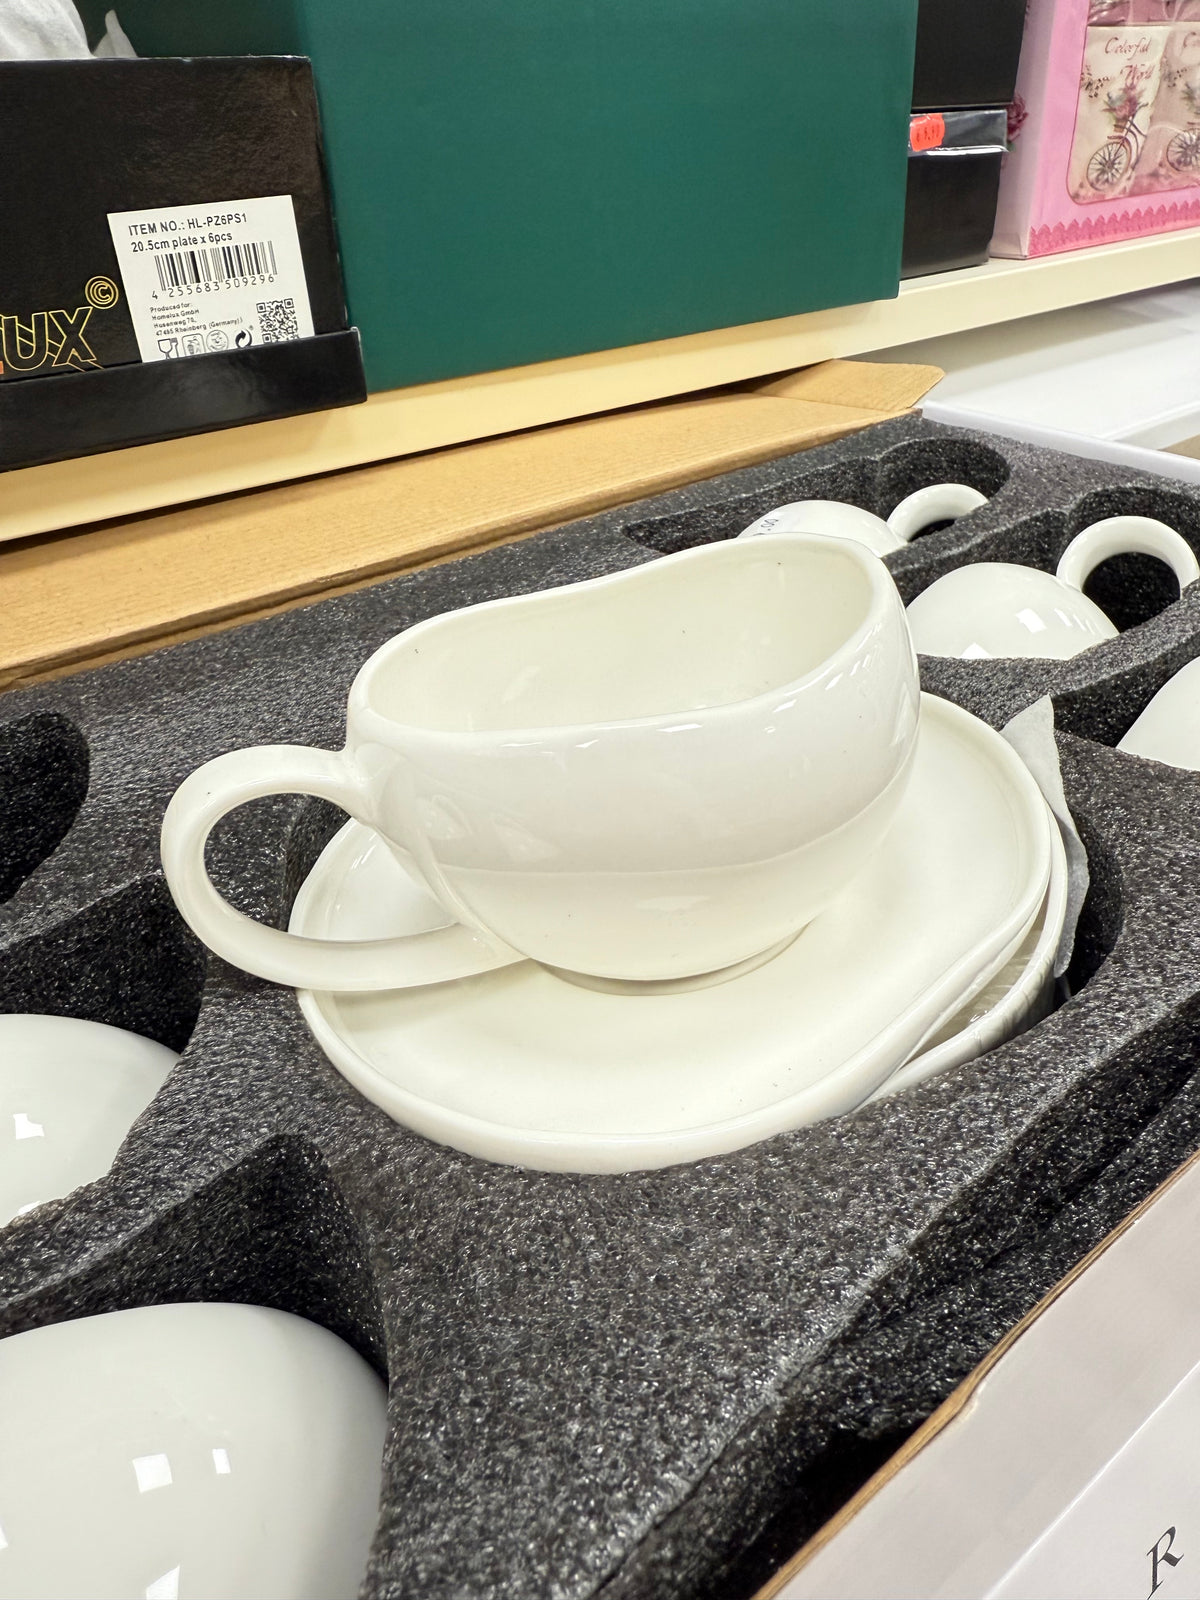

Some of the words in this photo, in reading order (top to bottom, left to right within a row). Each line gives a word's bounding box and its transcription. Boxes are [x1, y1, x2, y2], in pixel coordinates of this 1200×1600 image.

[128, 222, 158, 236] ITEM
[160, 220, 186, 233] NO.:
[187, 212, 247, 230] HL-PZ6PS1
[131, 240, 170, 253] 20.5cm
[172, 236, 198, 249] plate
[200, 235, 207, 244] x
[208, 232, 233, 245] 6pcs
